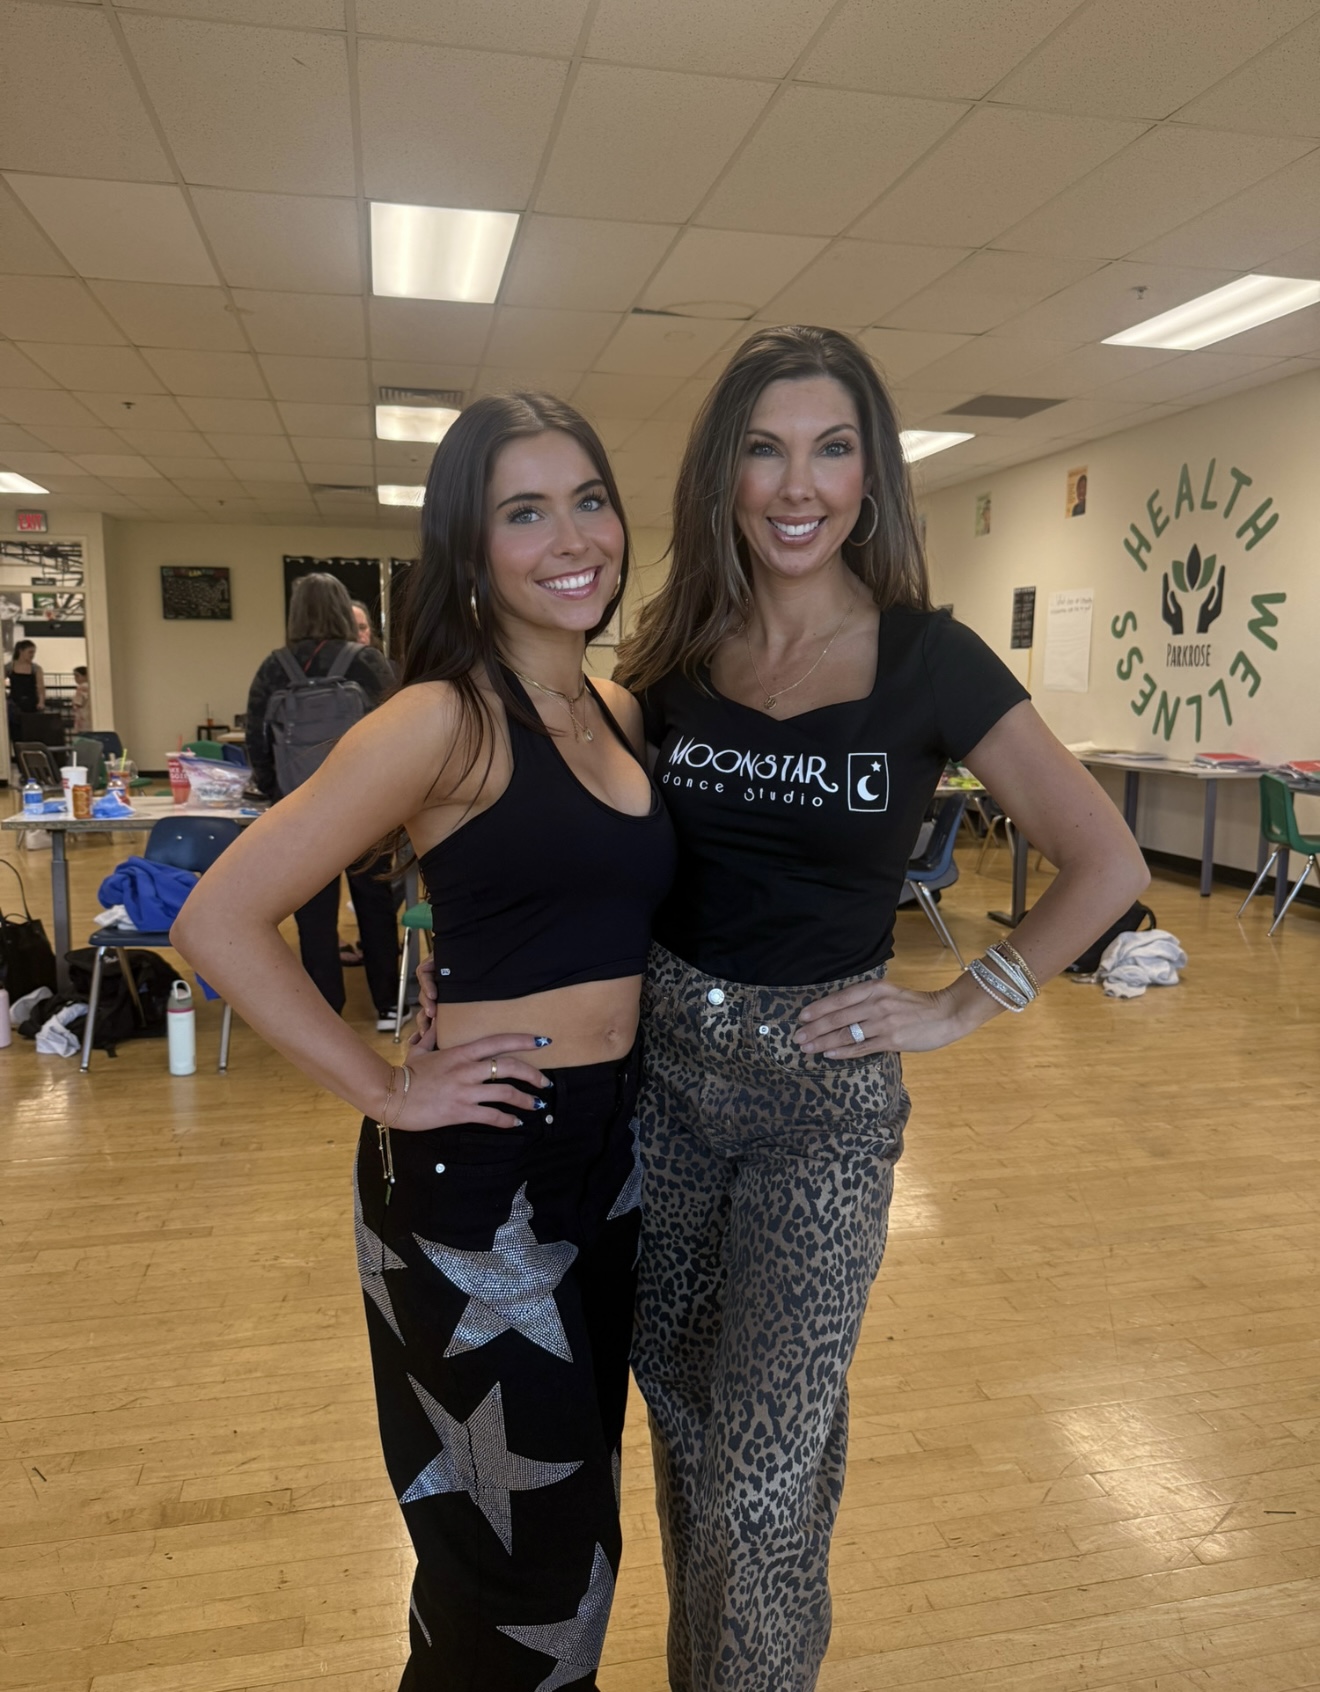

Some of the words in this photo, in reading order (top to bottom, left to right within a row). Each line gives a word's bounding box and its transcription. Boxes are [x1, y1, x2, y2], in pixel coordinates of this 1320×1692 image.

[18, 512, 43, 531] EXIT
[1123, 457, 1280, 572] HEALTH
[1111, 592, 1287, 743] WELLNESS
[1166, 643, 1212, 667] PARKROSE
[662, 771, 725, 793] dance
[668, 735, 839, 793] MOONSTAR
